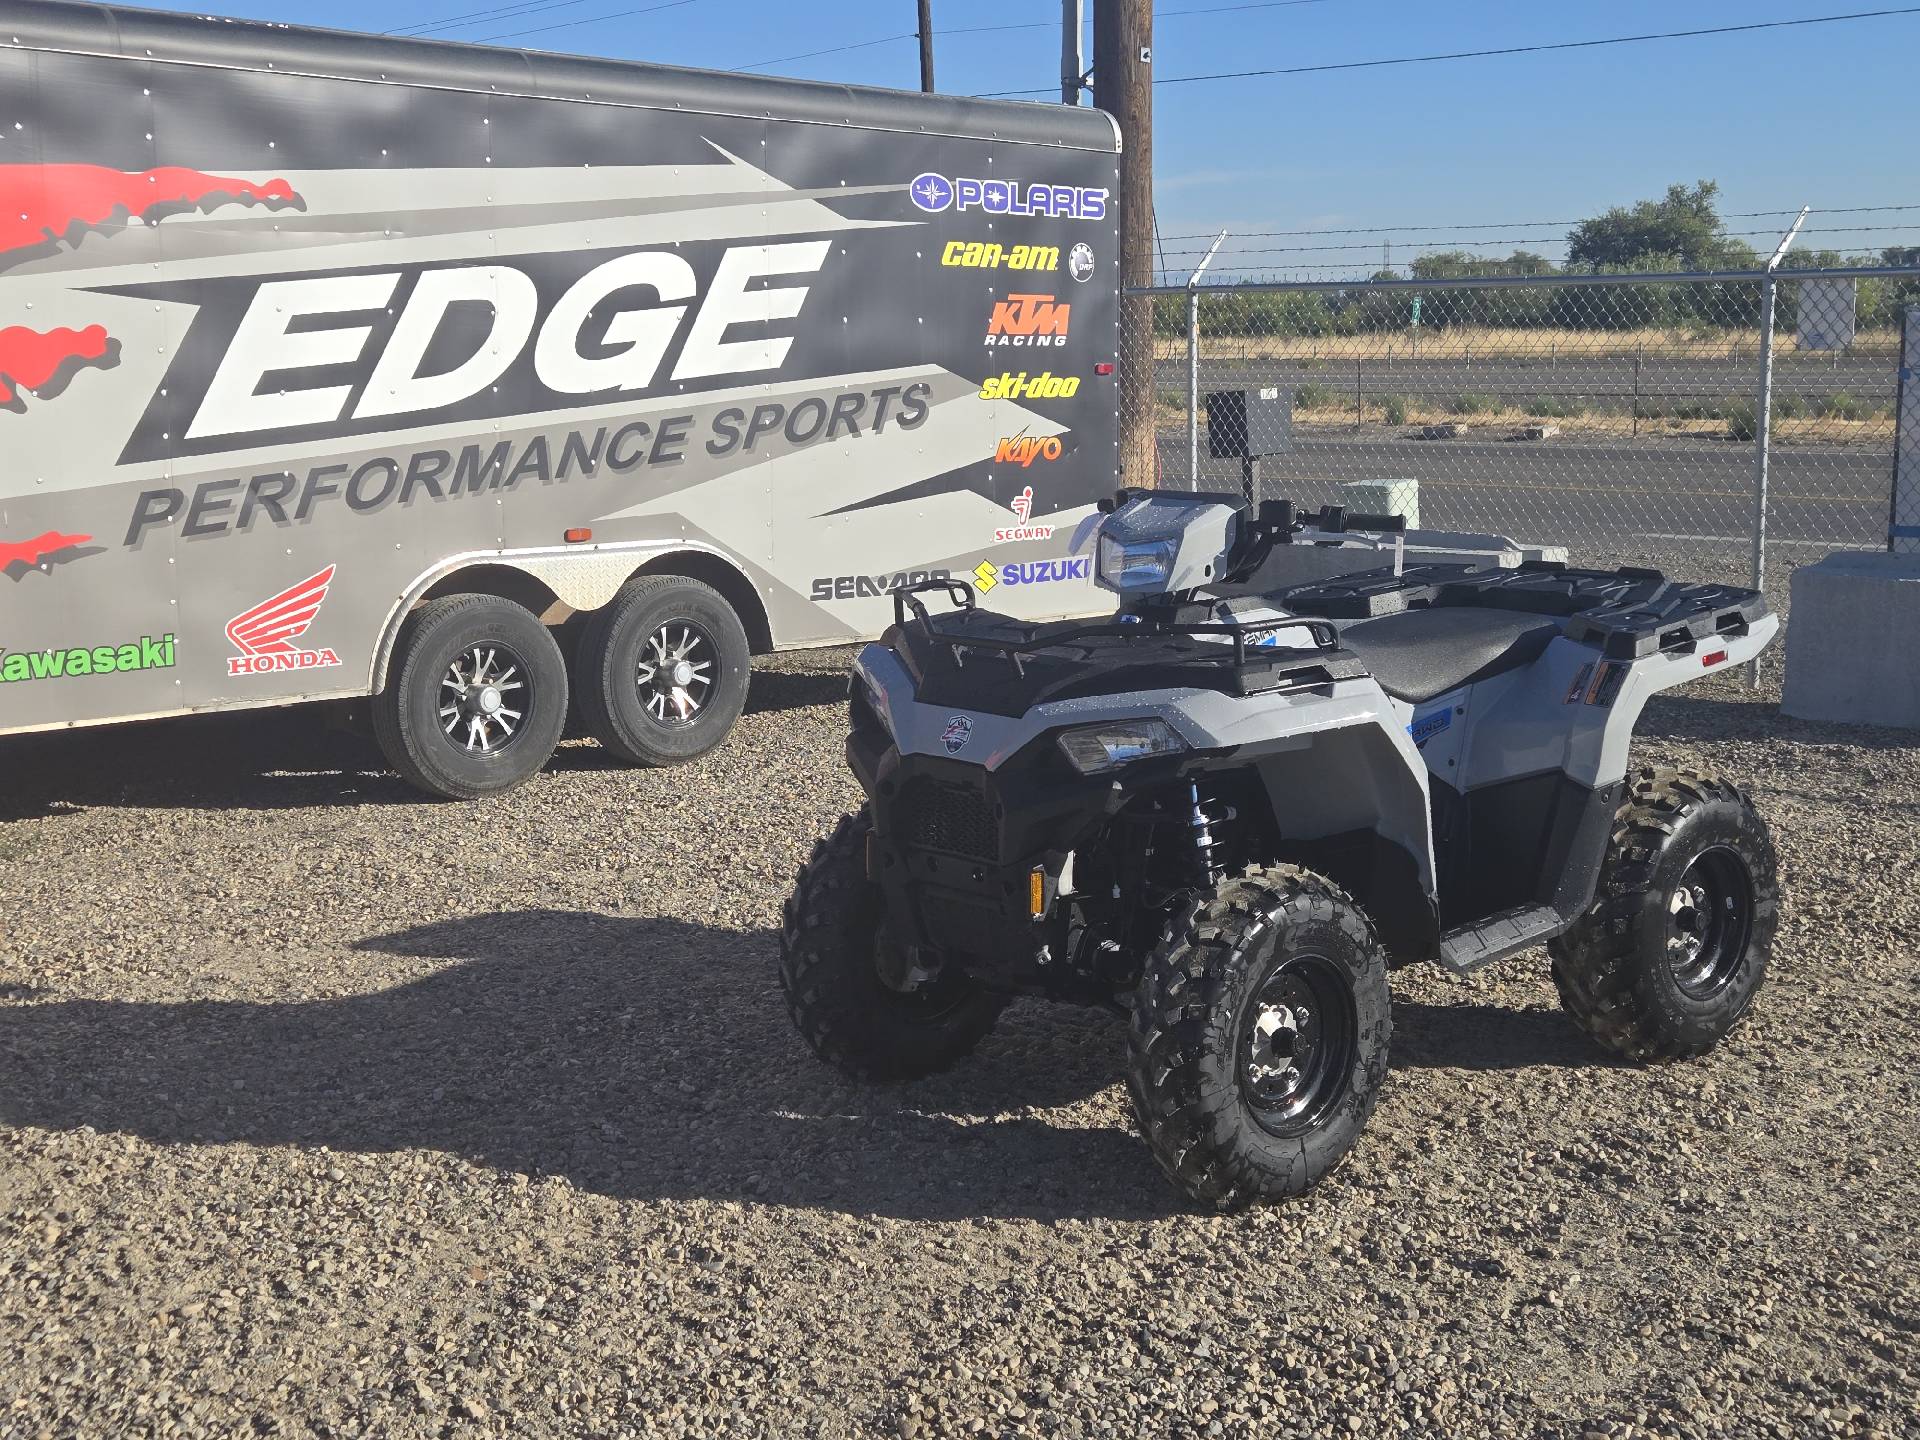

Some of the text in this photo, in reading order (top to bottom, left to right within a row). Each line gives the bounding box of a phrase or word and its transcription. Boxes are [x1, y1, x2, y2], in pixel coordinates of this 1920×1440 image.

[956, 178, 1107, 220] POLARIS
[941, 241, 1059, 270] can-am
[988, 293, 1071, 335] KTM
[183, 240, 833, 440] EDGE
[984, 334, 1067, 346] RACING
[979, 371, 1080, 400] ski-doo
[995, 425, 1063, 468] KAYO
[122, 382, 932, 548] PERFORMANCE SPORTS
[995, 527, 1053, 541] SEGWAY
[1002, 558, 1089, 586] SUZUKI
[0, 633, 175, 682] awasaki
[227, 649, 343, 676] HONDA
